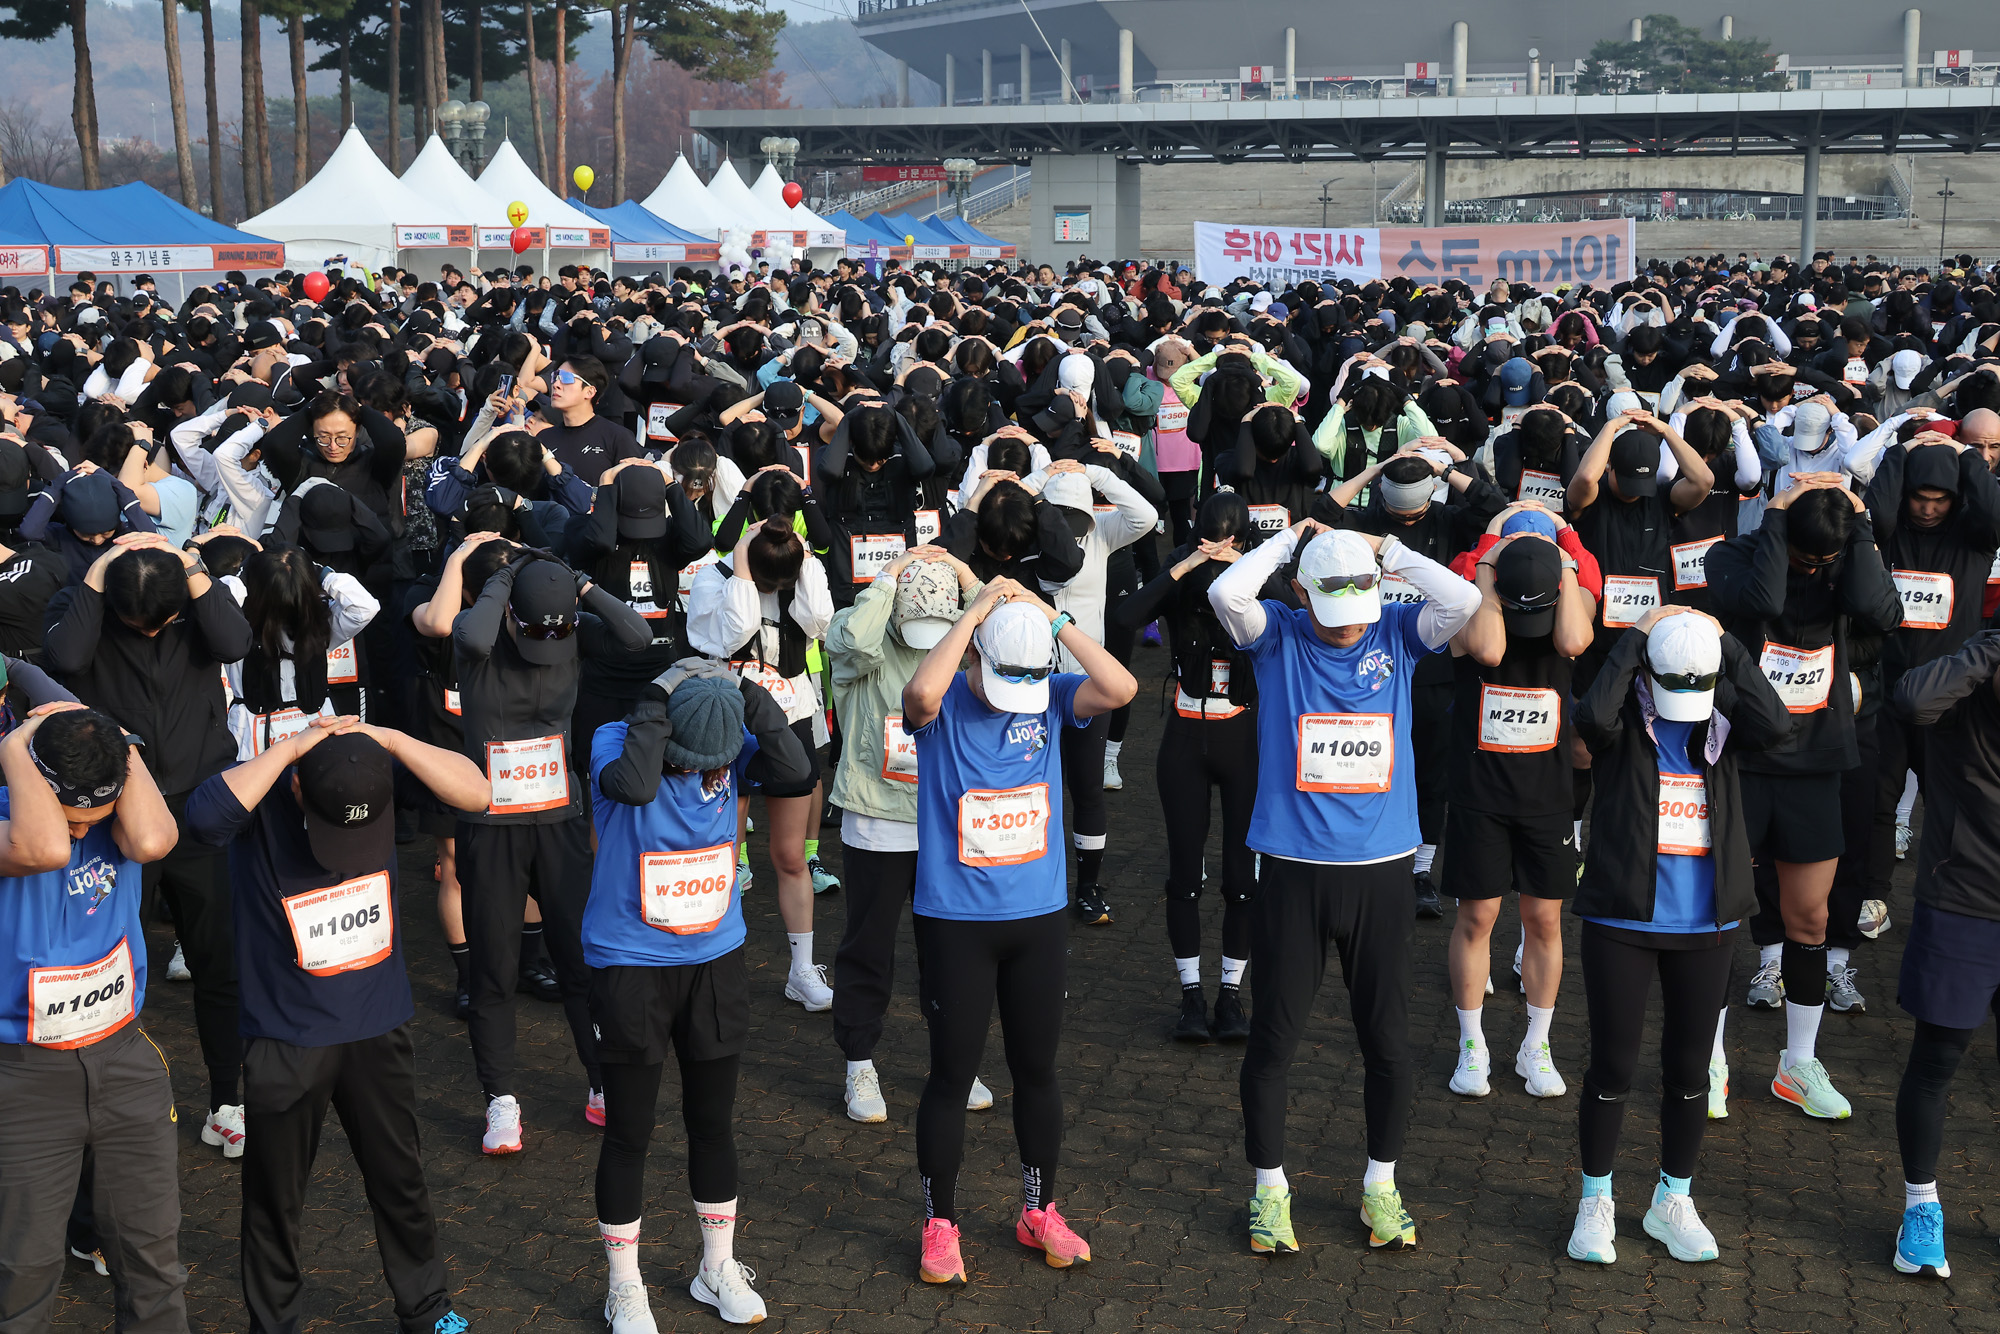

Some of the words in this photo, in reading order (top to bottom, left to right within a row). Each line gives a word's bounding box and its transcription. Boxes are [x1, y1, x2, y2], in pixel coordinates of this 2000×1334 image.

[217, 251, 245, 261] BURNING
[246, 251, 258, 261] RUN
[258, 250, 279, 261] STORY
[1384, 592, 1422, 604] M124
[1903, 590, 1943, 604] 1941
[1769, 648, 1797, 659] BURNING
[1766, 656, 1790, 667] F-106
[1487, 689, 1513, 698] BURNING
[1306, 718, 1338, 726] BURNING
[534, 742, 552, 751] STORY
[1658, 801, 1709, 820] 3005
[648, 857, 682, 866] BURNING
[682, 855, 698, 864] RUN
[698, 852, 721, 862] STORY
[293, 893, 328, 910] BURNING
[329, 888, 345, 901] RUN
[346, 881, 372, 894] STORY
[649, 916, 669, 924] 10km
[307, 958, 327, 968] 10km
[38, 967, 80, 984] BURNING
[81, 965, 99, 978] RUN
[100, 954, 120, 973] STORY
[38, 1033, 62, 1042] 10km
